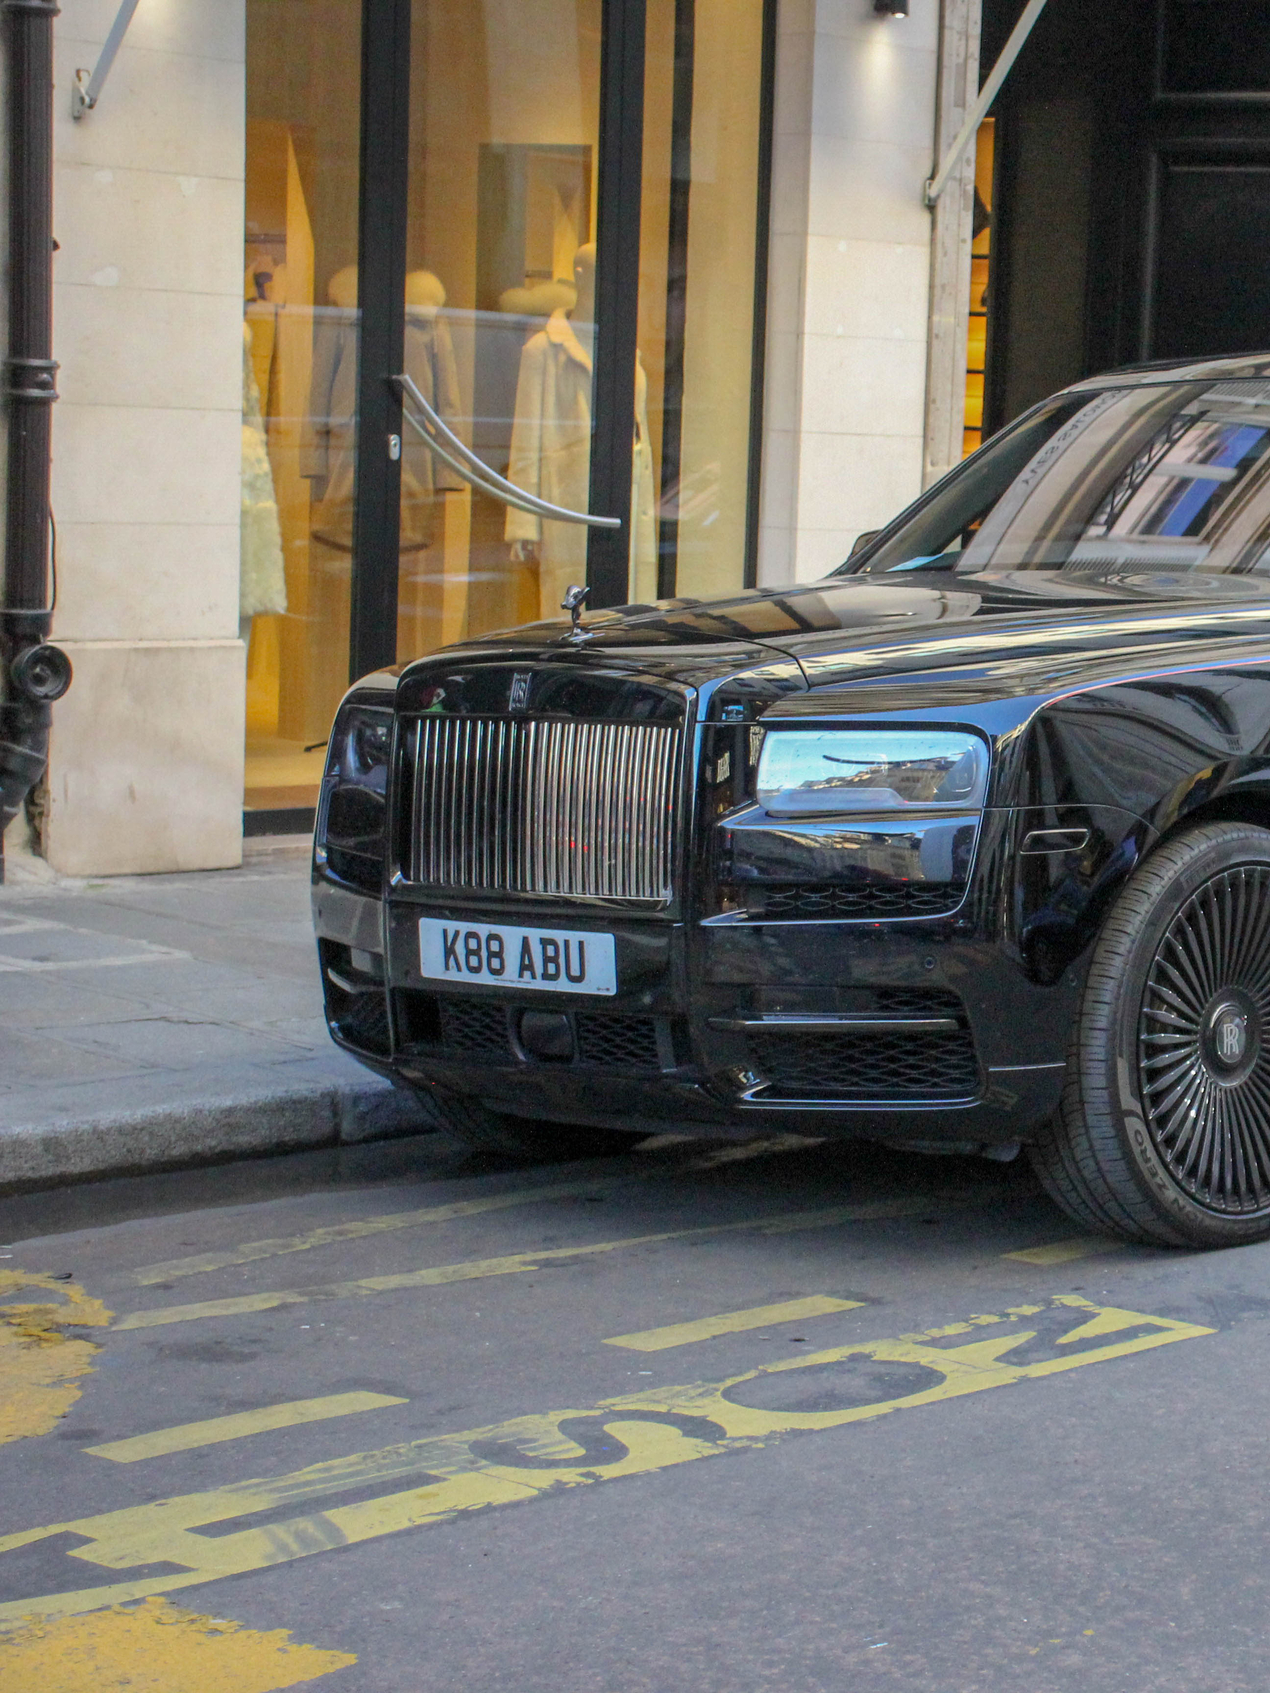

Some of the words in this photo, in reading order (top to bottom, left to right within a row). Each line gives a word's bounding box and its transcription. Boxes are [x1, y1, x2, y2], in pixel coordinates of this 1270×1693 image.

[442, 928, 506, 977] K88
[518, 935, 587, 984] ABU
[1134, 1127, 1171, 1196] ZERO
